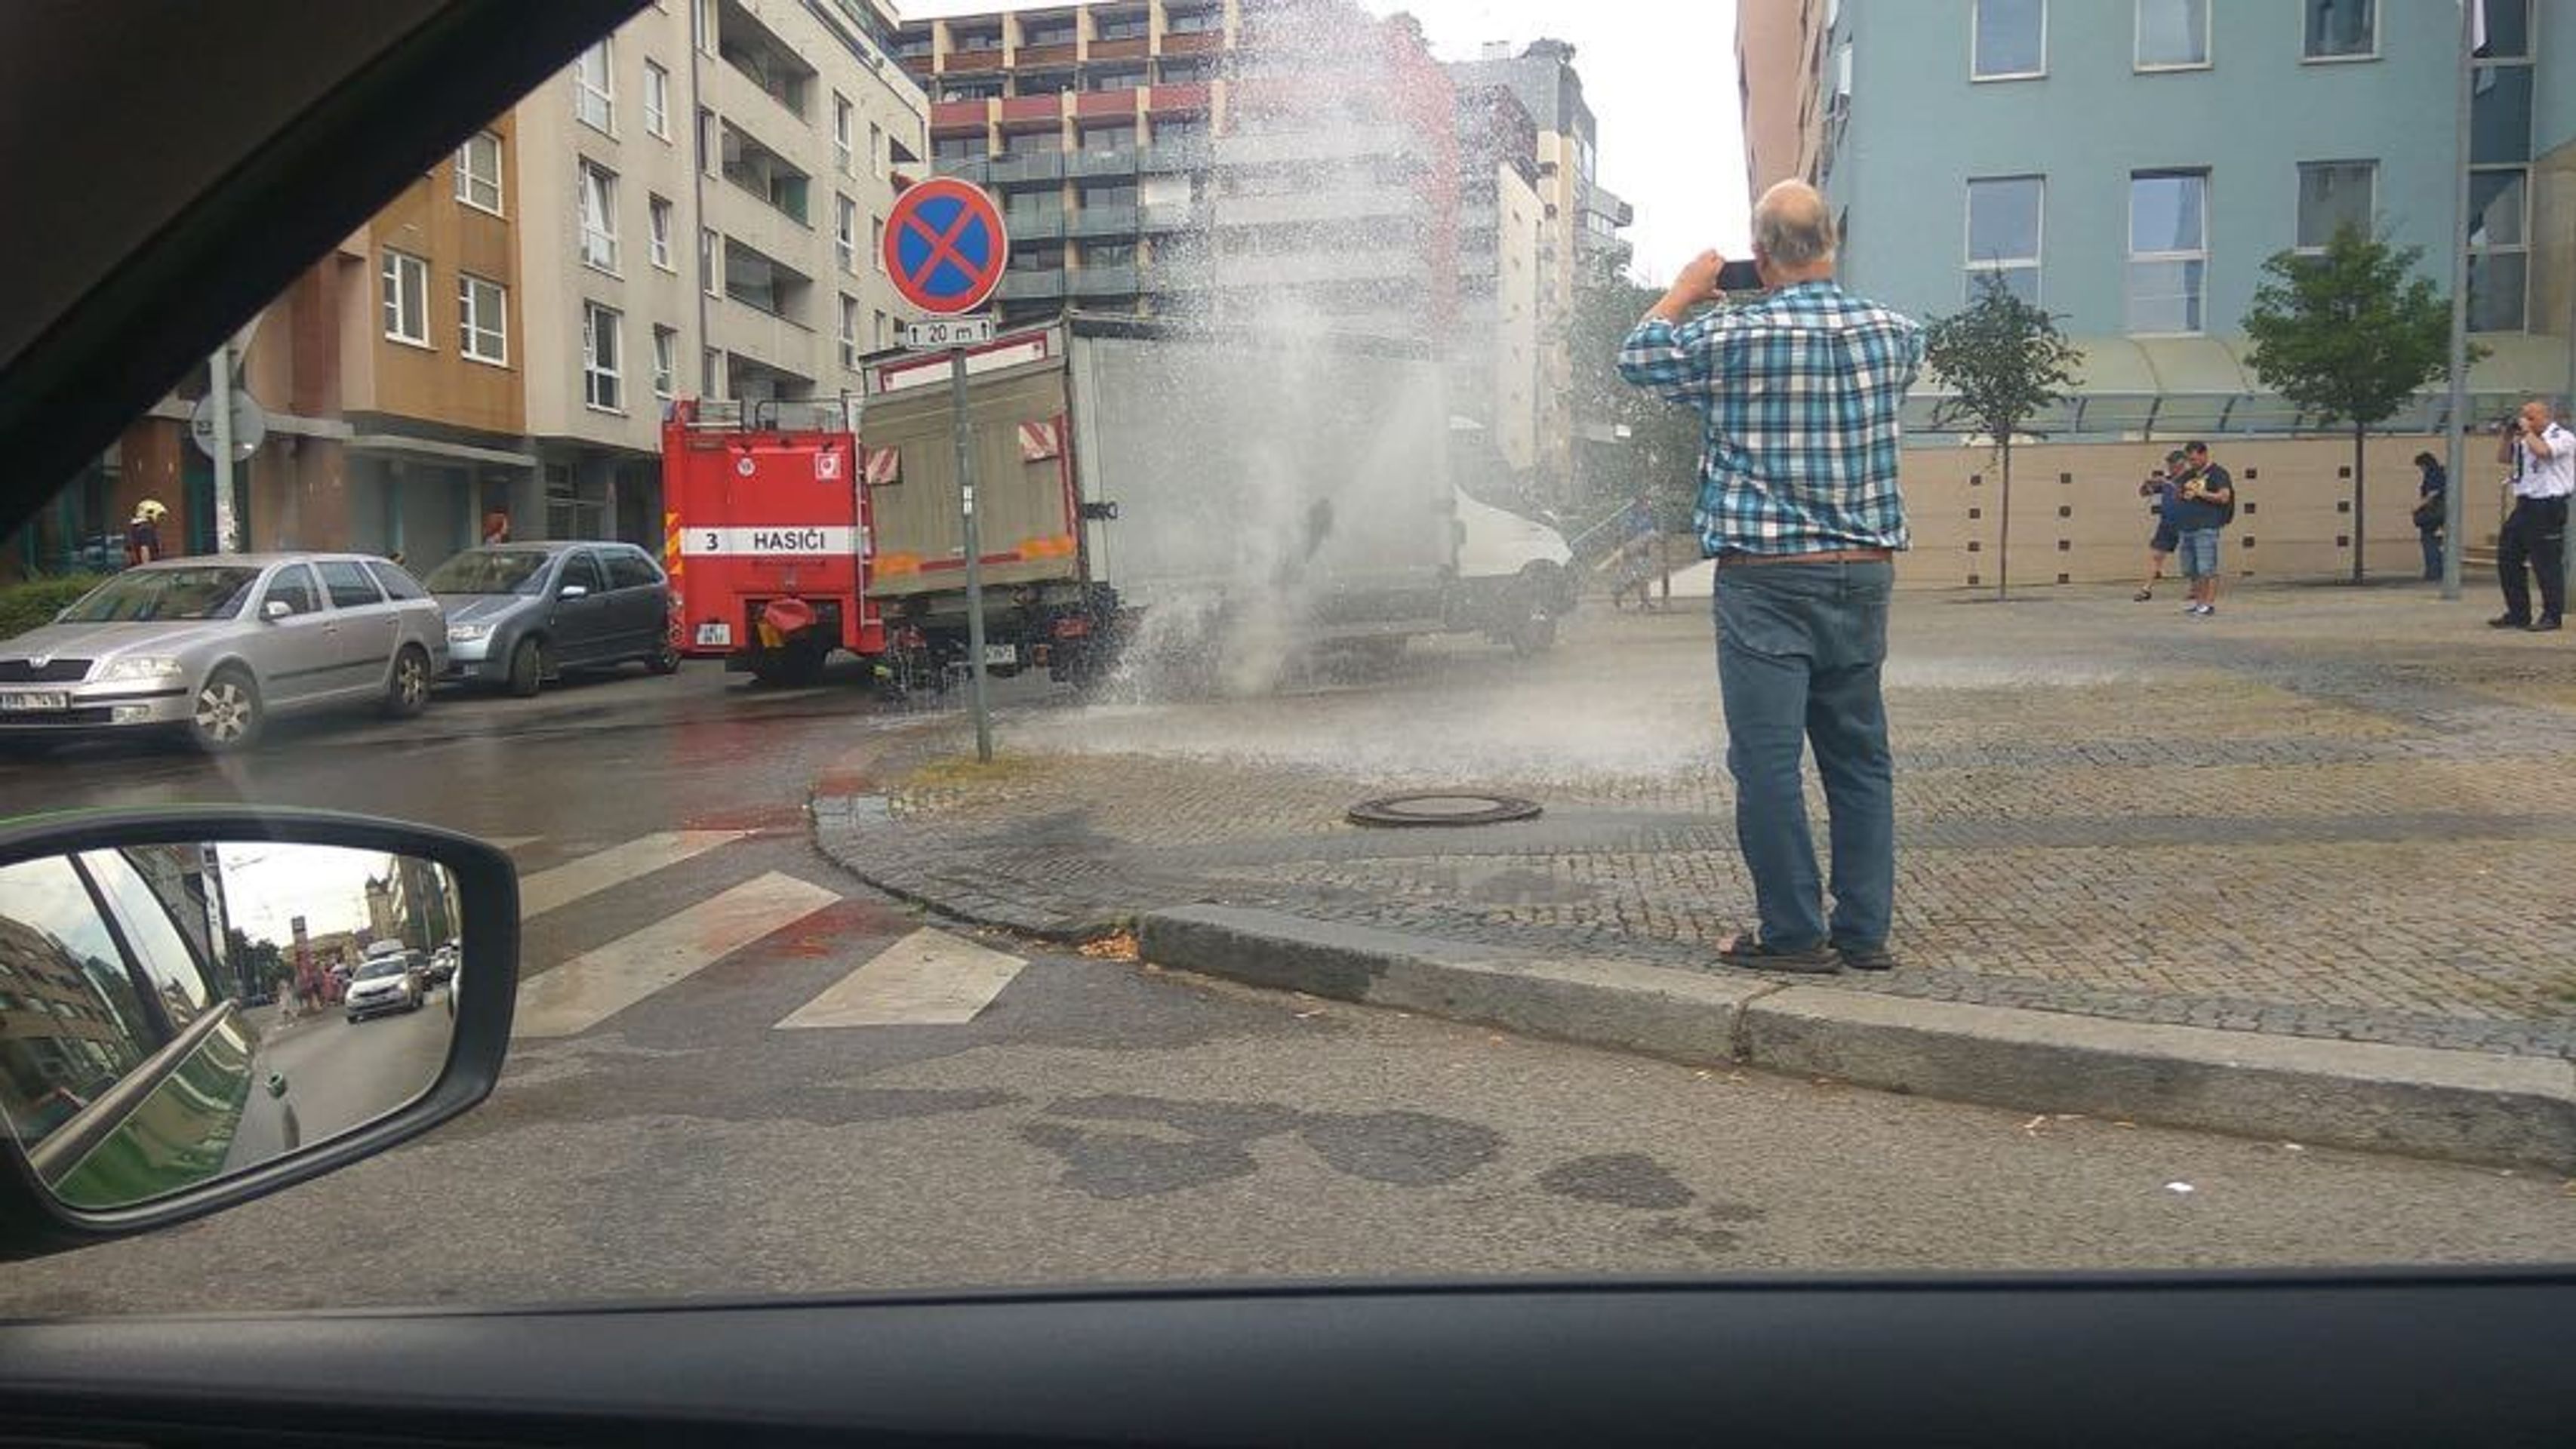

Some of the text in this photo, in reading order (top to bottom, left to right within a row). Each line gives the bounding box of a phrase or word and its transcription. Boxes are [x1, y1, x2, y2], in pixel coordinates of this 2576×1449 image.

[928, 324, 972, 342] 20 m
[706, 533, 719, 550] 3
[754, 529, 825, 549] HASIČI
